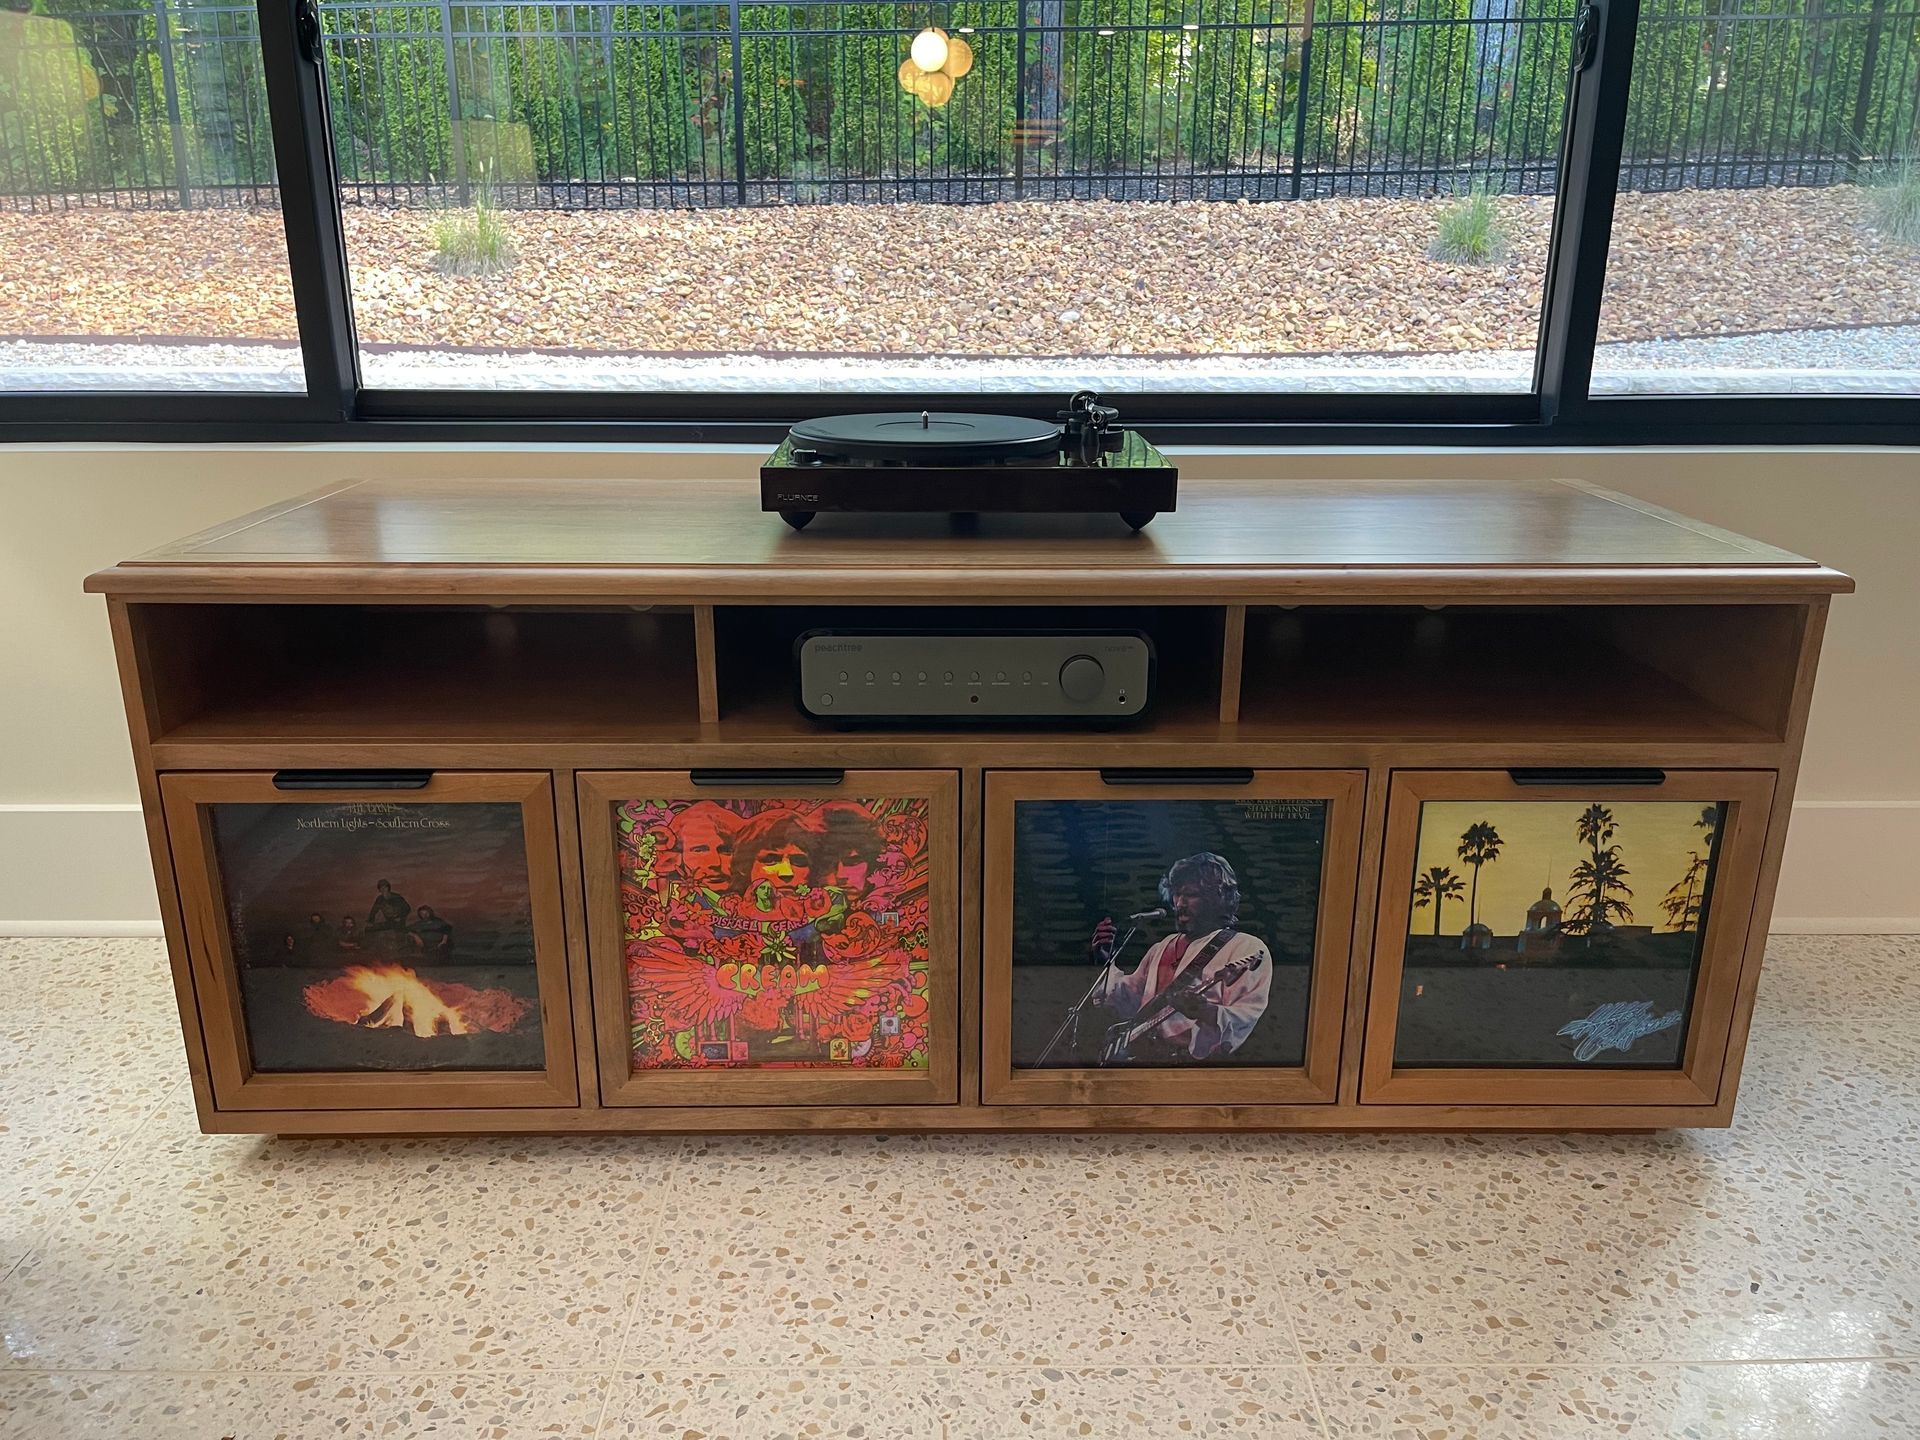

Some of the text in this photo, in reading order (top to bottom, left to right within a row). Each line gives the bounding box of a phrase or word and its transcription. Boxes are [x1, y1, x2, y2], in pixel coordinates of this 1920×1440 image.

[777, 493, 819, 502] FLUANCE
[815, 644, 863, 653] peachtree
[297, 816, 340, 830] Northern
[341, 817, 368, 831] Lights
[375, 816, 420, 829] Southern
[420, 817, 450, 829] Cross
[771, 914, 809, 932] GEARS
[716, 963, 831, 991] CREAM
